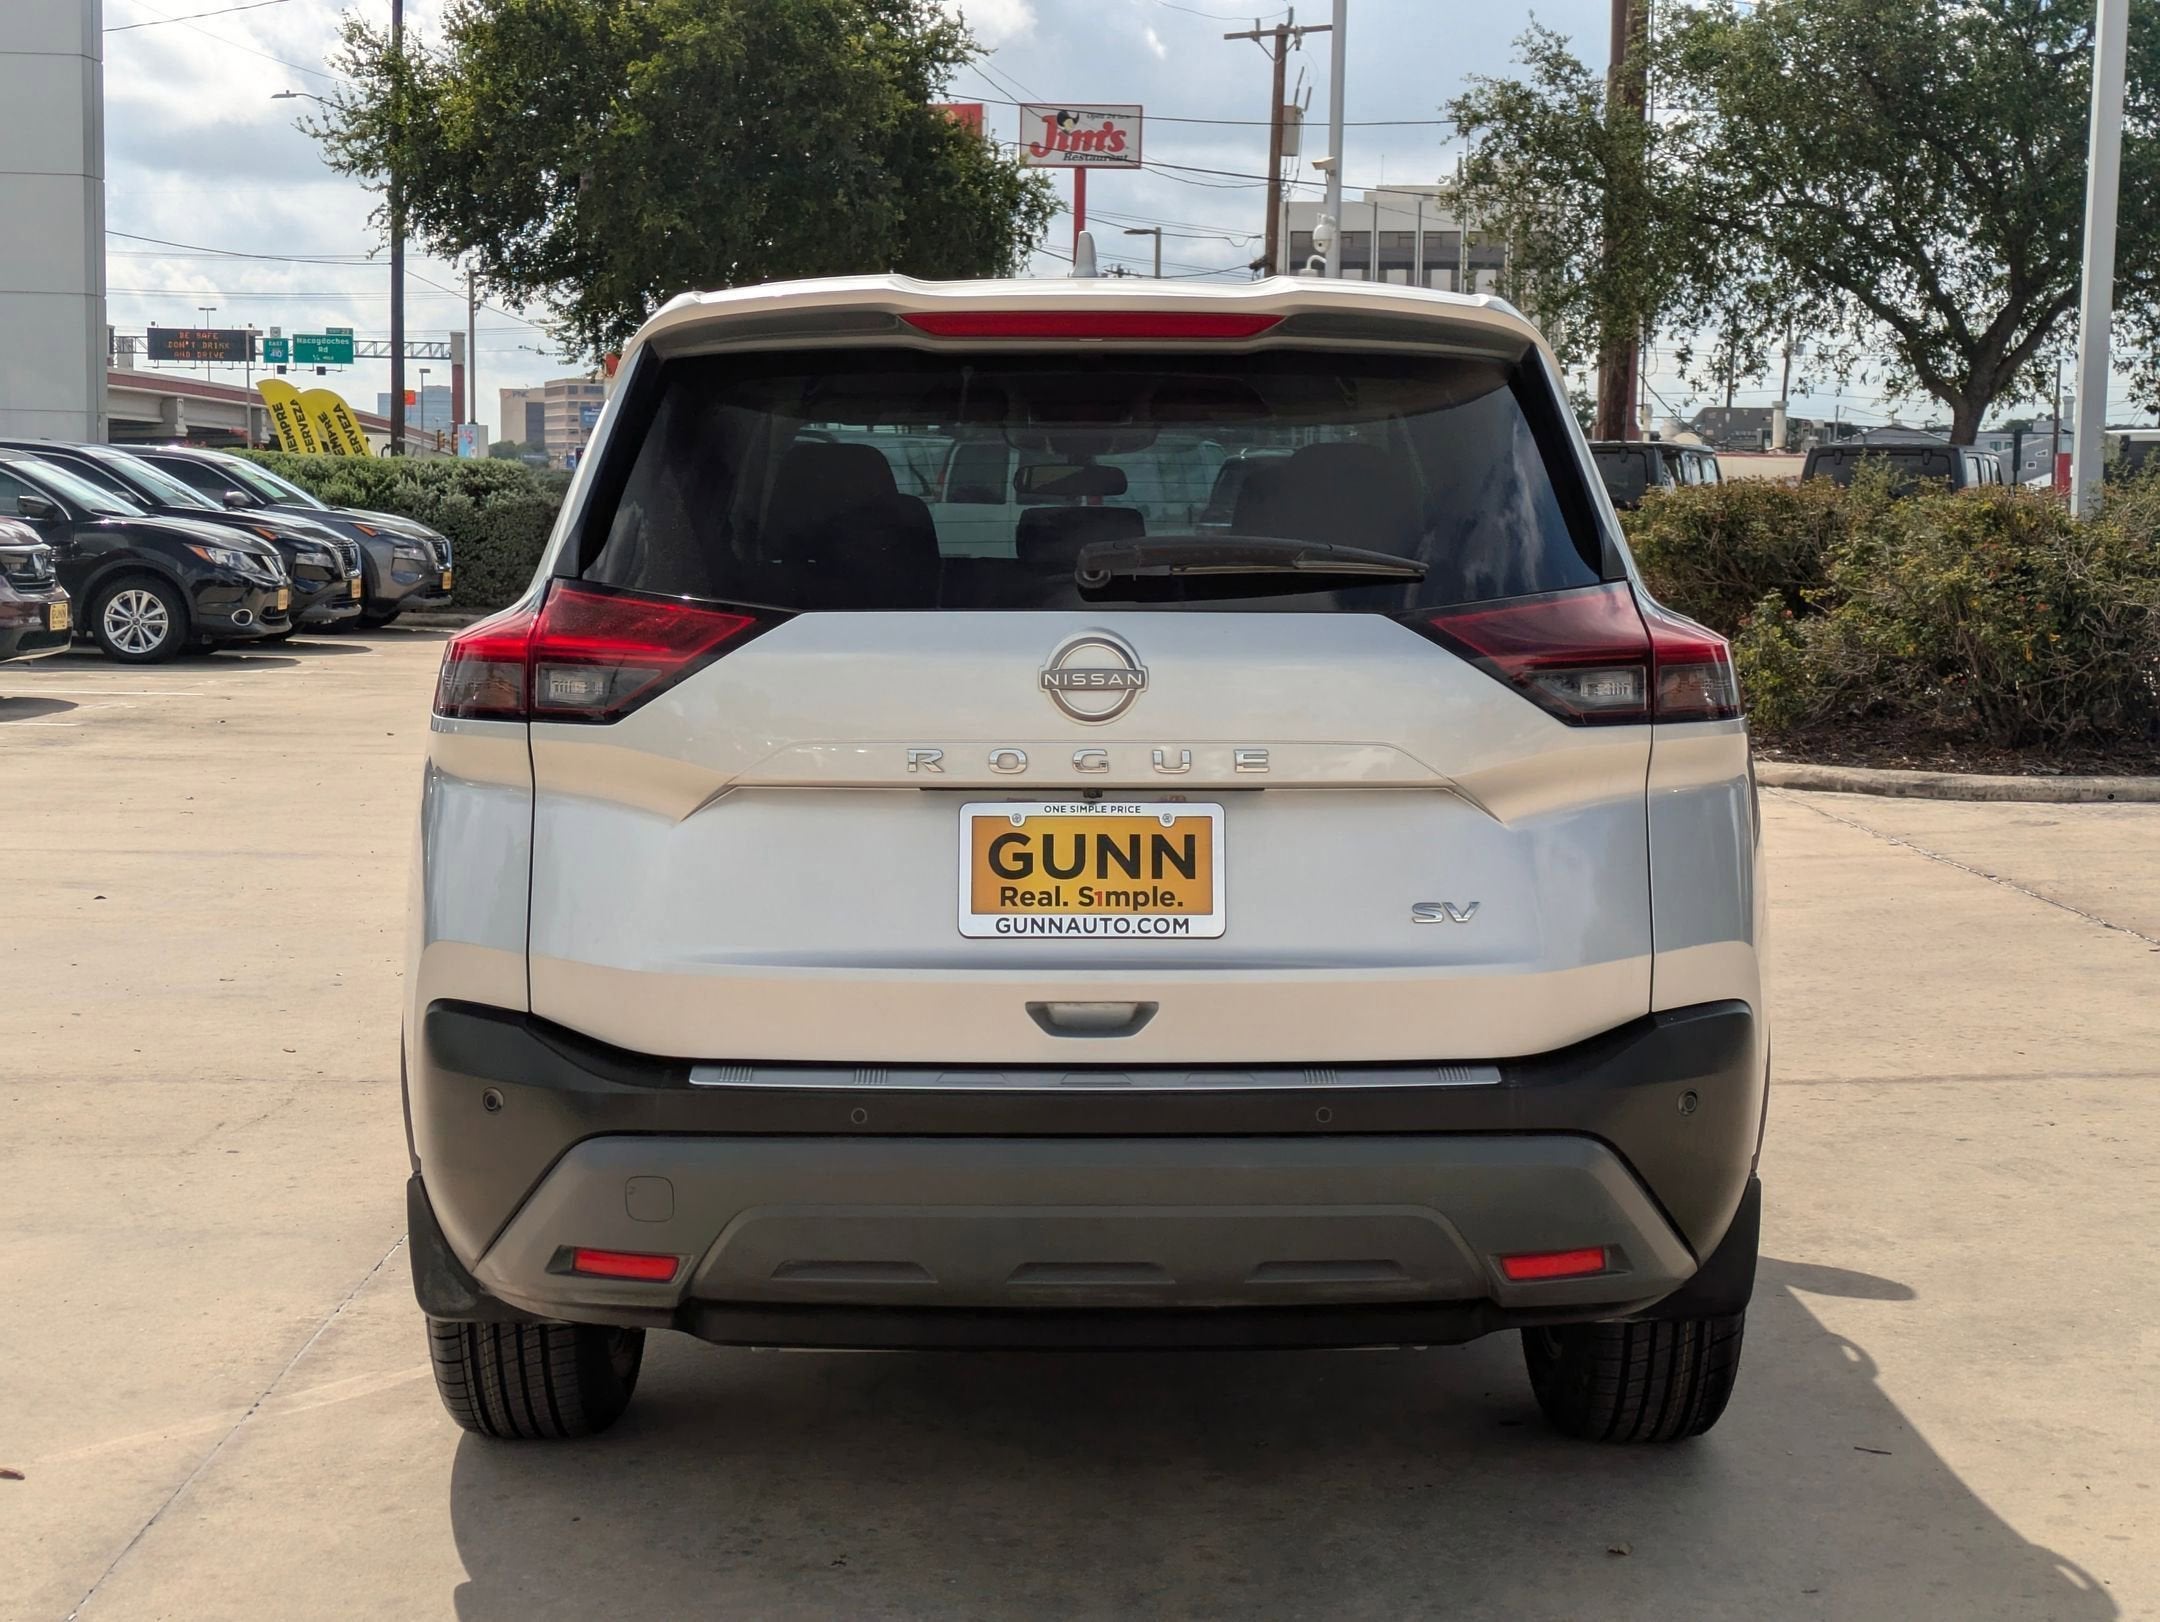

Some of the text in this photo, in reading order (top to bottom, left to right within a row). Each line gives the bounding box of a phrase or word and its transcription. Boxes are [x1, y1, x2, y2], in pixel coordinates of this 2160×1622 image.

[1030, 115, 1127, 158] Jim's
[196, 332, 219, 340] SAFE
[296, 337, 350, 346] Nacogdoches
[168, 341, 230, 350] DON'T DRINK
[269, 350, 283, 359] 410
[290, 399, 317, 454] CERVEZA
[1044, 672, 1143, 687] NISSAN
[906, 748, 1270, 774] ROGUE
[1044, 805, 1141, 814] ONE SIMPLE PRICE
[988, 832, 1196, 880] GUNN
[1000, 886, 1069, 907] Real.
[1412, 902, 1480, 924] SV
[995, 917, 1190, 934] GUNNAUTO.COM
